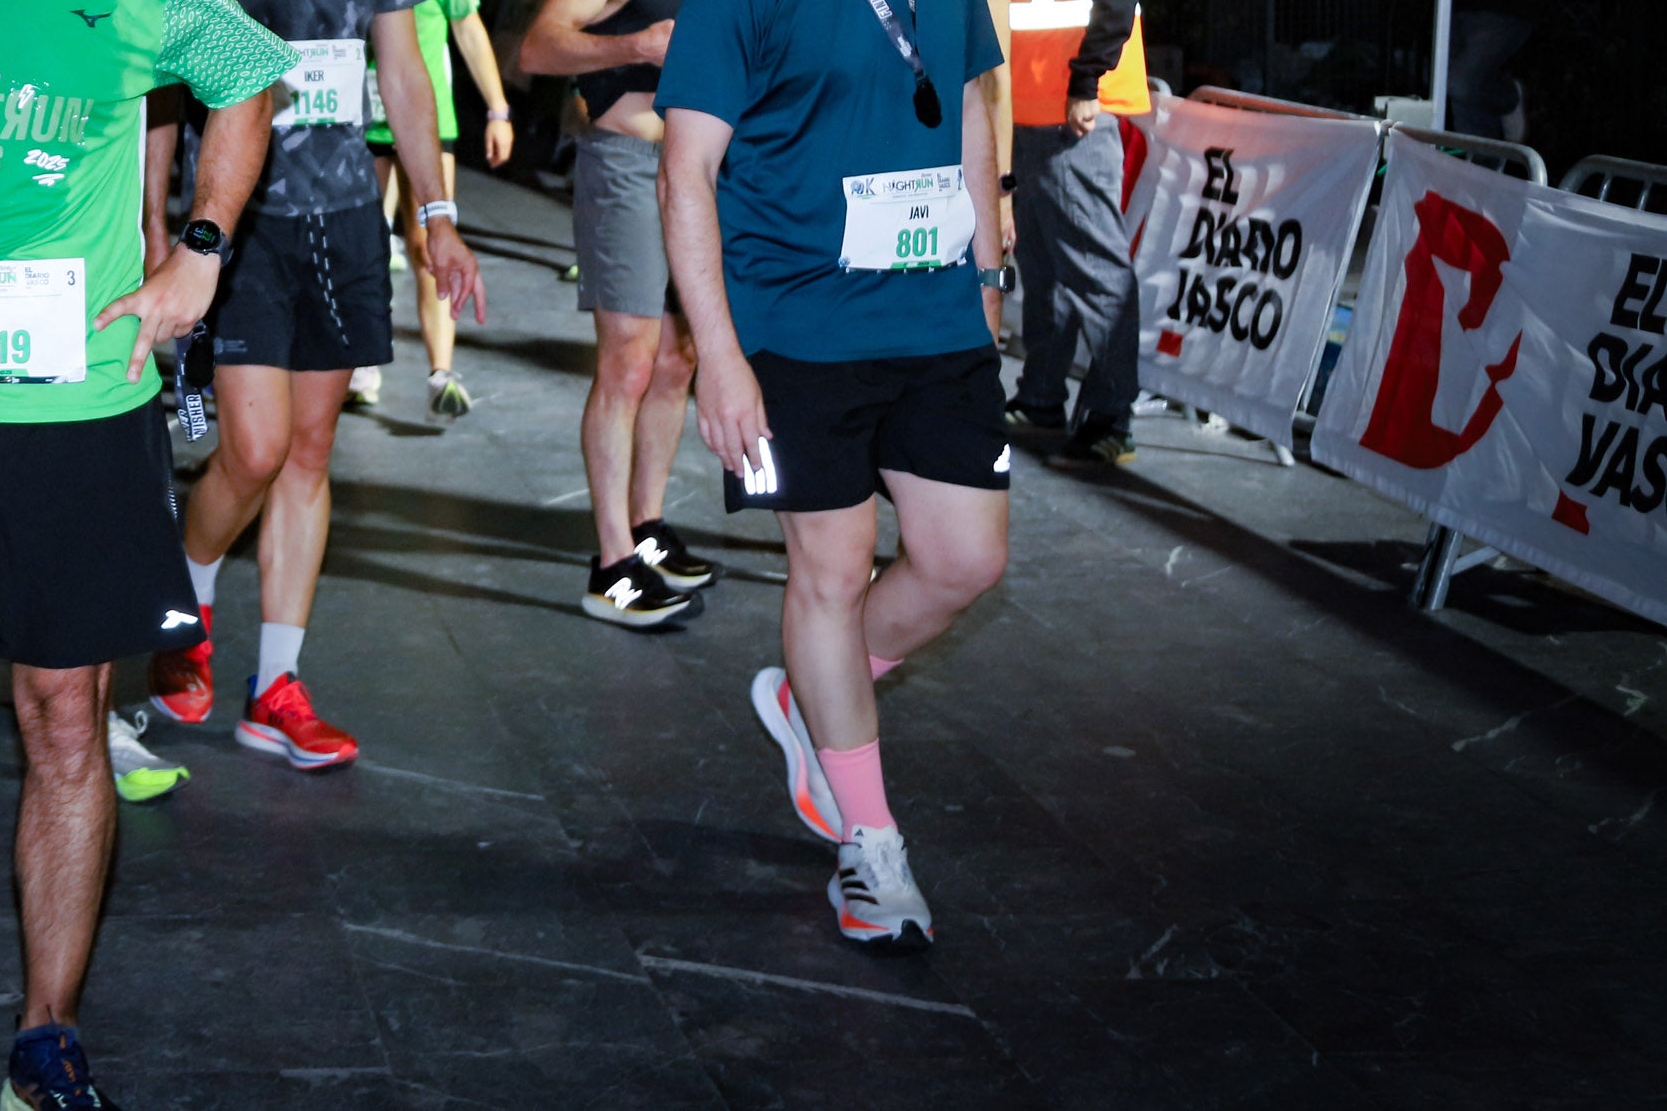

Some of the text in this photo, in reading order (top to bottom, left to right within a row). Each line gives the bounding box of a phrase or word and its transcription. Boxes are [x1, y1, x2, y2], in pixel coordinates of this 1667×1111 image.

[304, 70, 324, 82] IKER
[290, 88, 338, 115] 1146
[24, 148, 71, 171] 2025
[1201, 147, 1238, 205] EL
[909, 205, 929, 220] JAVI
[896, 226, 938, 258] 801
[67, 270, 76, 286] 3
[1565, 413, 1667, 513] VAS
